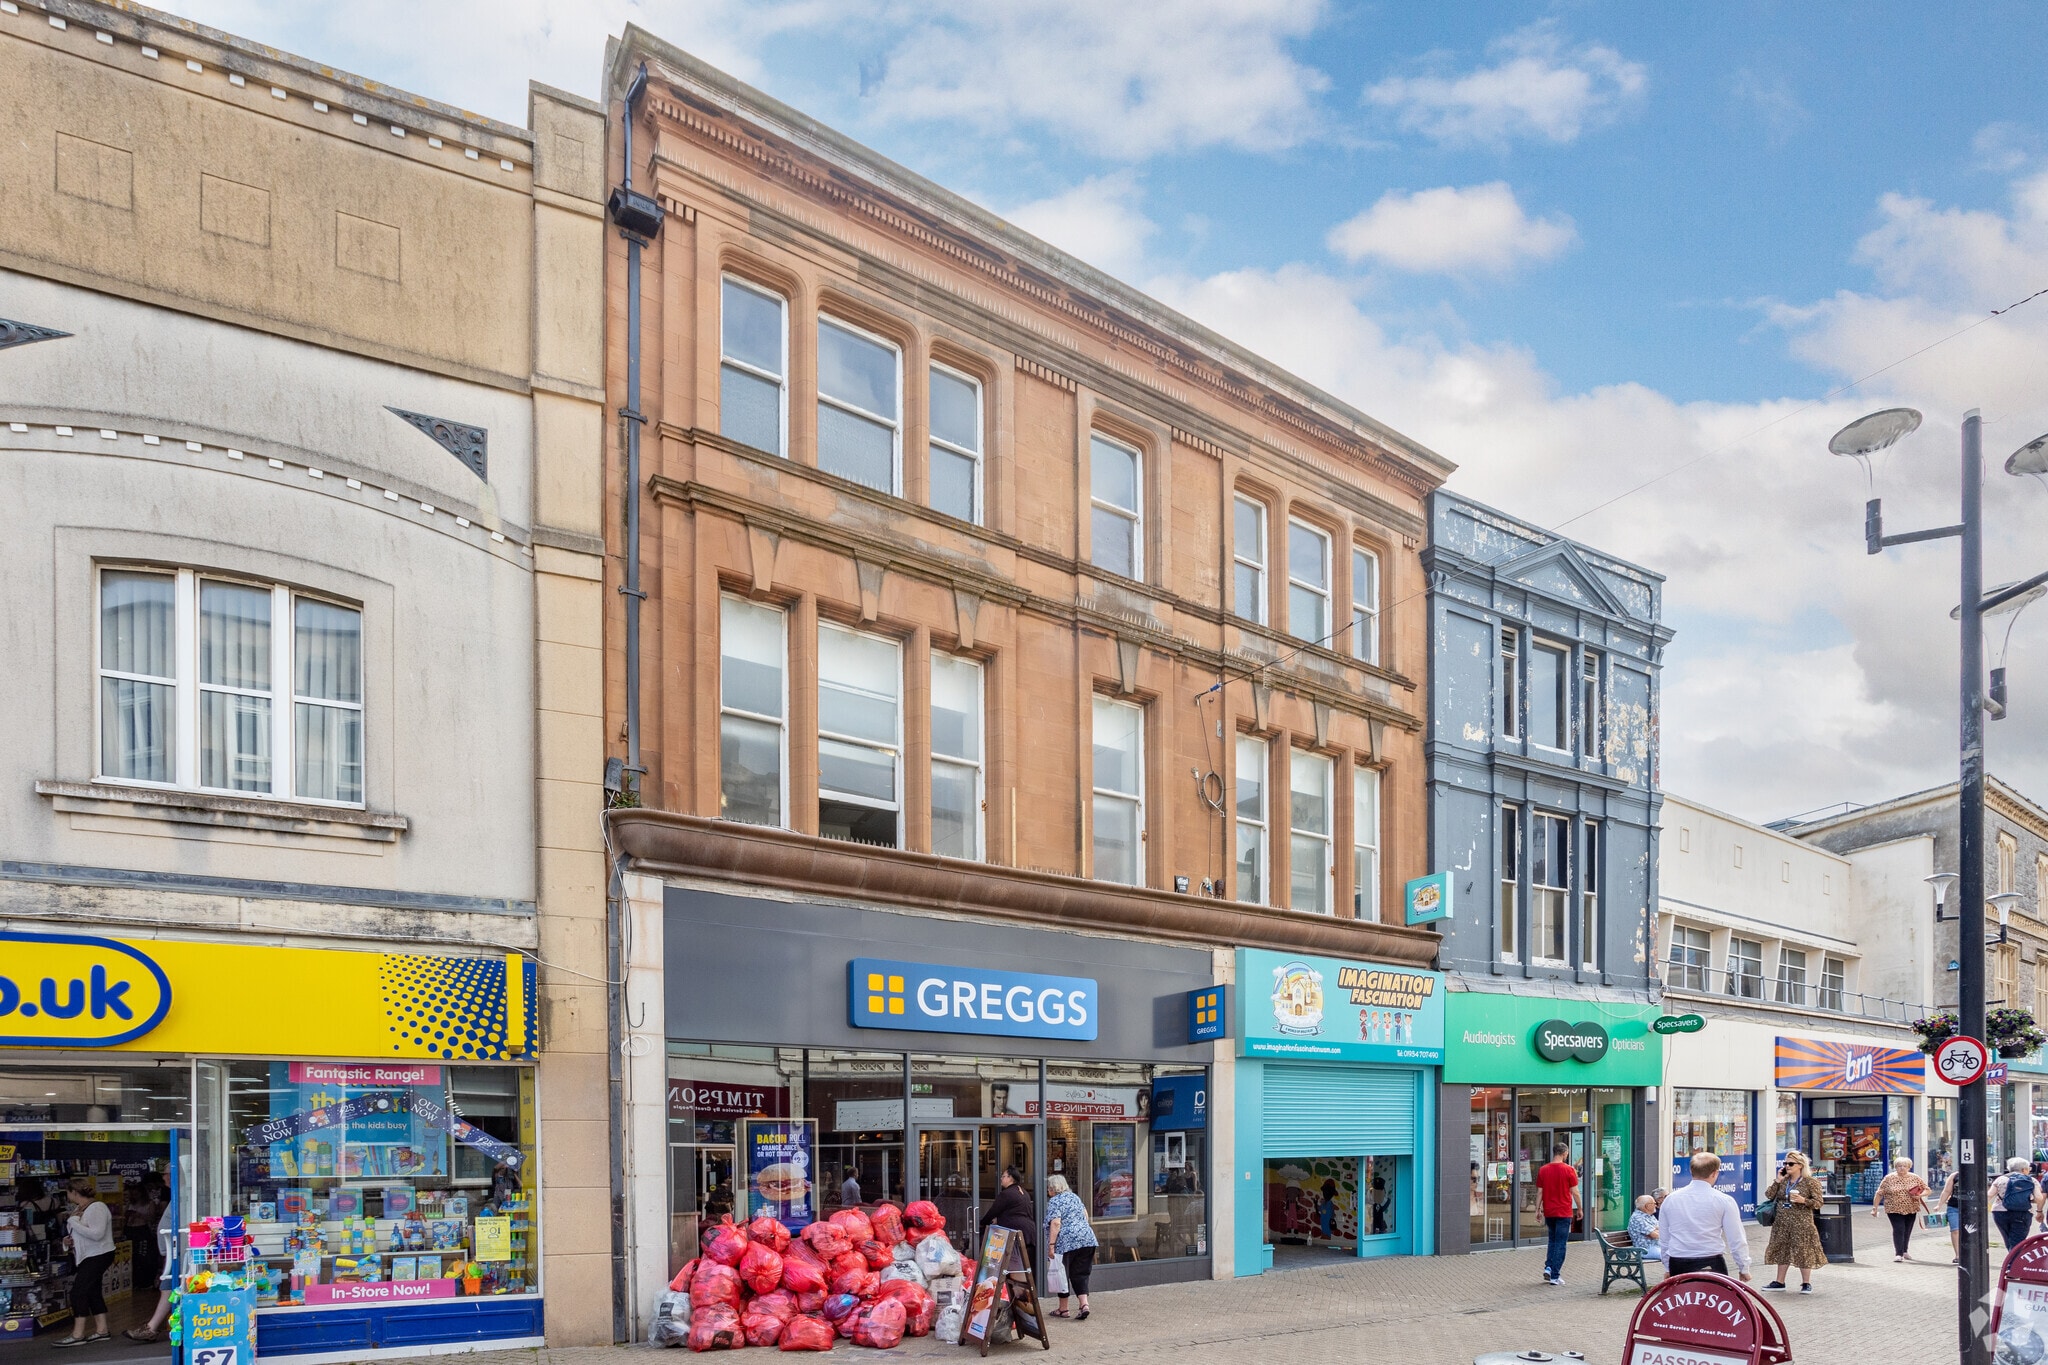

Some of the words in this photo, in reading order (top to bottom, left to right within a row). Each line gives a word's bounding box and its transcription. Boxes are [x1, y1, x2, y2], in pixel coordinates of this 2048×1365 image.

[1339, 968, 1434, 995] IMAGINATION
[917, 978, 1087, 1026] GREGGS
[1351, 990, 1423, 1009] FASCINATION
[1196, 1026, 1217, 1035] GREGGS
[1657, 1018, 1698, 1030] Specsavers
[1463, 1030, 1516, 1047] Audiologists
[1544, 1031, 1603, 1050] Specsavers
[1612, 1037, 1645, 1052] Opticians
[306, 1066, 371, 1081] Fantastic
[375, 1069, 425, 1084] Range!
[411, 1103, 438, 1122] NOW
[418, 1098, 442, 1114] OUT
[261, 1118, 287, 1133] OUT
[351, 1121, 366, 1129] the
[368, 1121, 385, 1129] kids
[387, 1122, 407, 1131] busy
[262, 1127, 293, 1143] NOW
[757, 1134, 787, 1144] BACON
[789, 1133, 805, 1142] ROLL
[1964, 1153, 1971, 1161] 8
[111, 1162, 148, 1171] Amazing
[121, 1169, 140, 1177] Gifts
[1744, 1161, 1752, 1170] PET
[1612, 1170, 1621, 1199] Contact
[1744, 1183, 1752, 1192] DIY
[1744, 1204, 1754, 1213] TOYS
[331, 1286, 389, 1299] In-Store
[393, 1283, 430, 1297] Now!
[200, 1304, 227, 1315] Fun
[1652, 1291, 1747, 1327] TIMPSON
[192, 1315, 216, 1327] for
[219, 1314, 235, 1326] all
[1669, 1324, 1690, 1332] Service
[193, 1325, 235, 1341] Ages!
